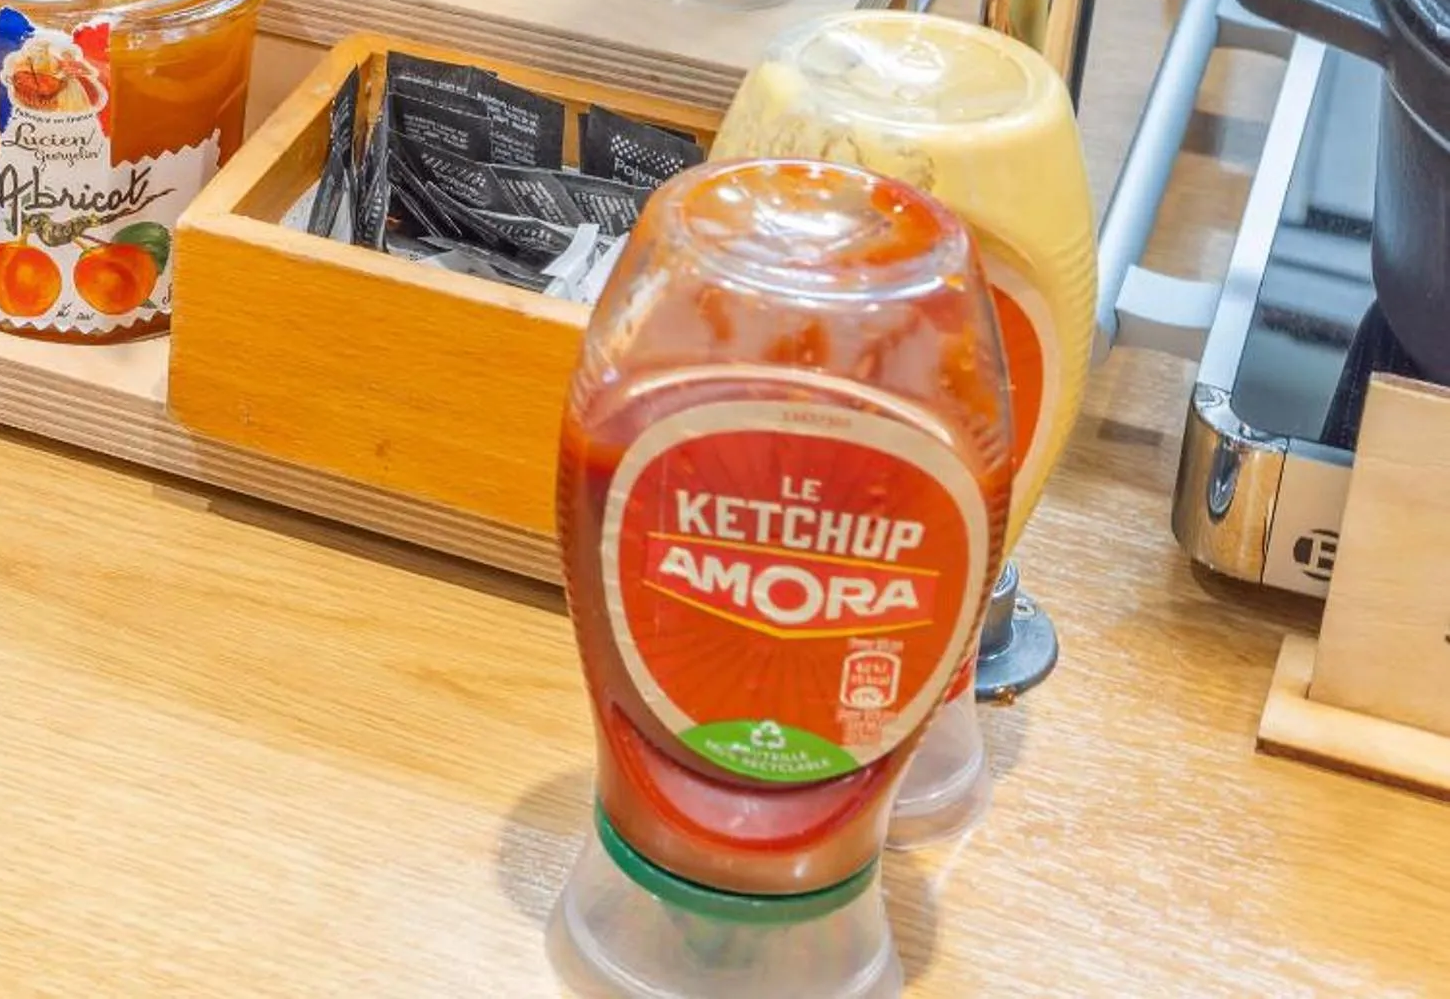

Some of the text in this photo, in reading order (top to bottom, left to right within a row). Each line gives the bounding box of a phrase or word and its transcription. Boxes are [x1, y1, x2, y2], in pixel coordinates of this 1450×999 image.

[1, 122, 96, 151] Lucien
[779, 475, 822, 503] LE
[674, 488, 926, 562] KETCHUP
[658, 545, 920, 625] AMORA
